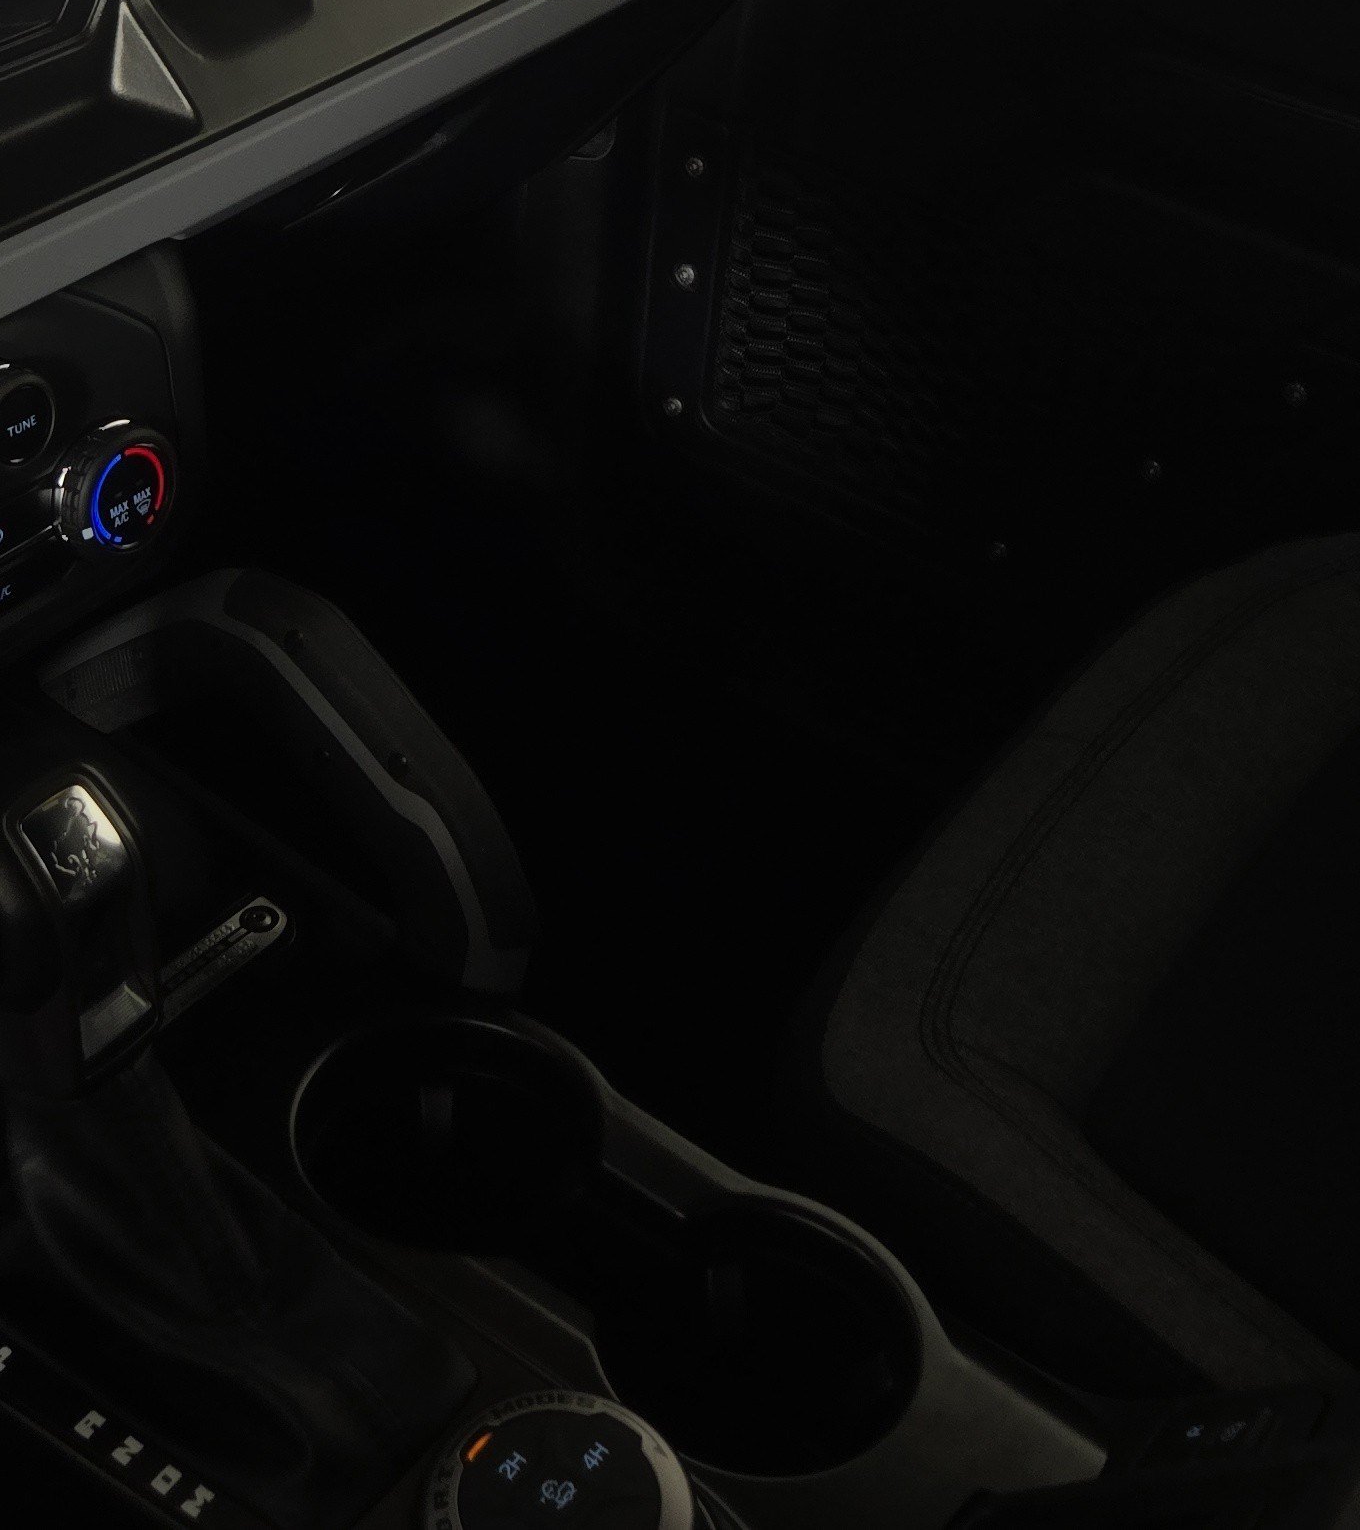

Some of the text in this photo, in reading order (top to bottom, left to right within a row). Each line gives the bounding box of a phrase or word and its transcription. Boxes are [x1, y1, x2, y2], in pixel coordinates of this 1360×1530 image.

[6, 414, 38, 438] TUNE
[133, 487, 152, 506] MAX
[109, 500, 129, 518] MAX
[114, 511, 130, 528] A/C
[498, 1450, 527, 1481] 2H
[582, 1441, 609, 1470] 4H
